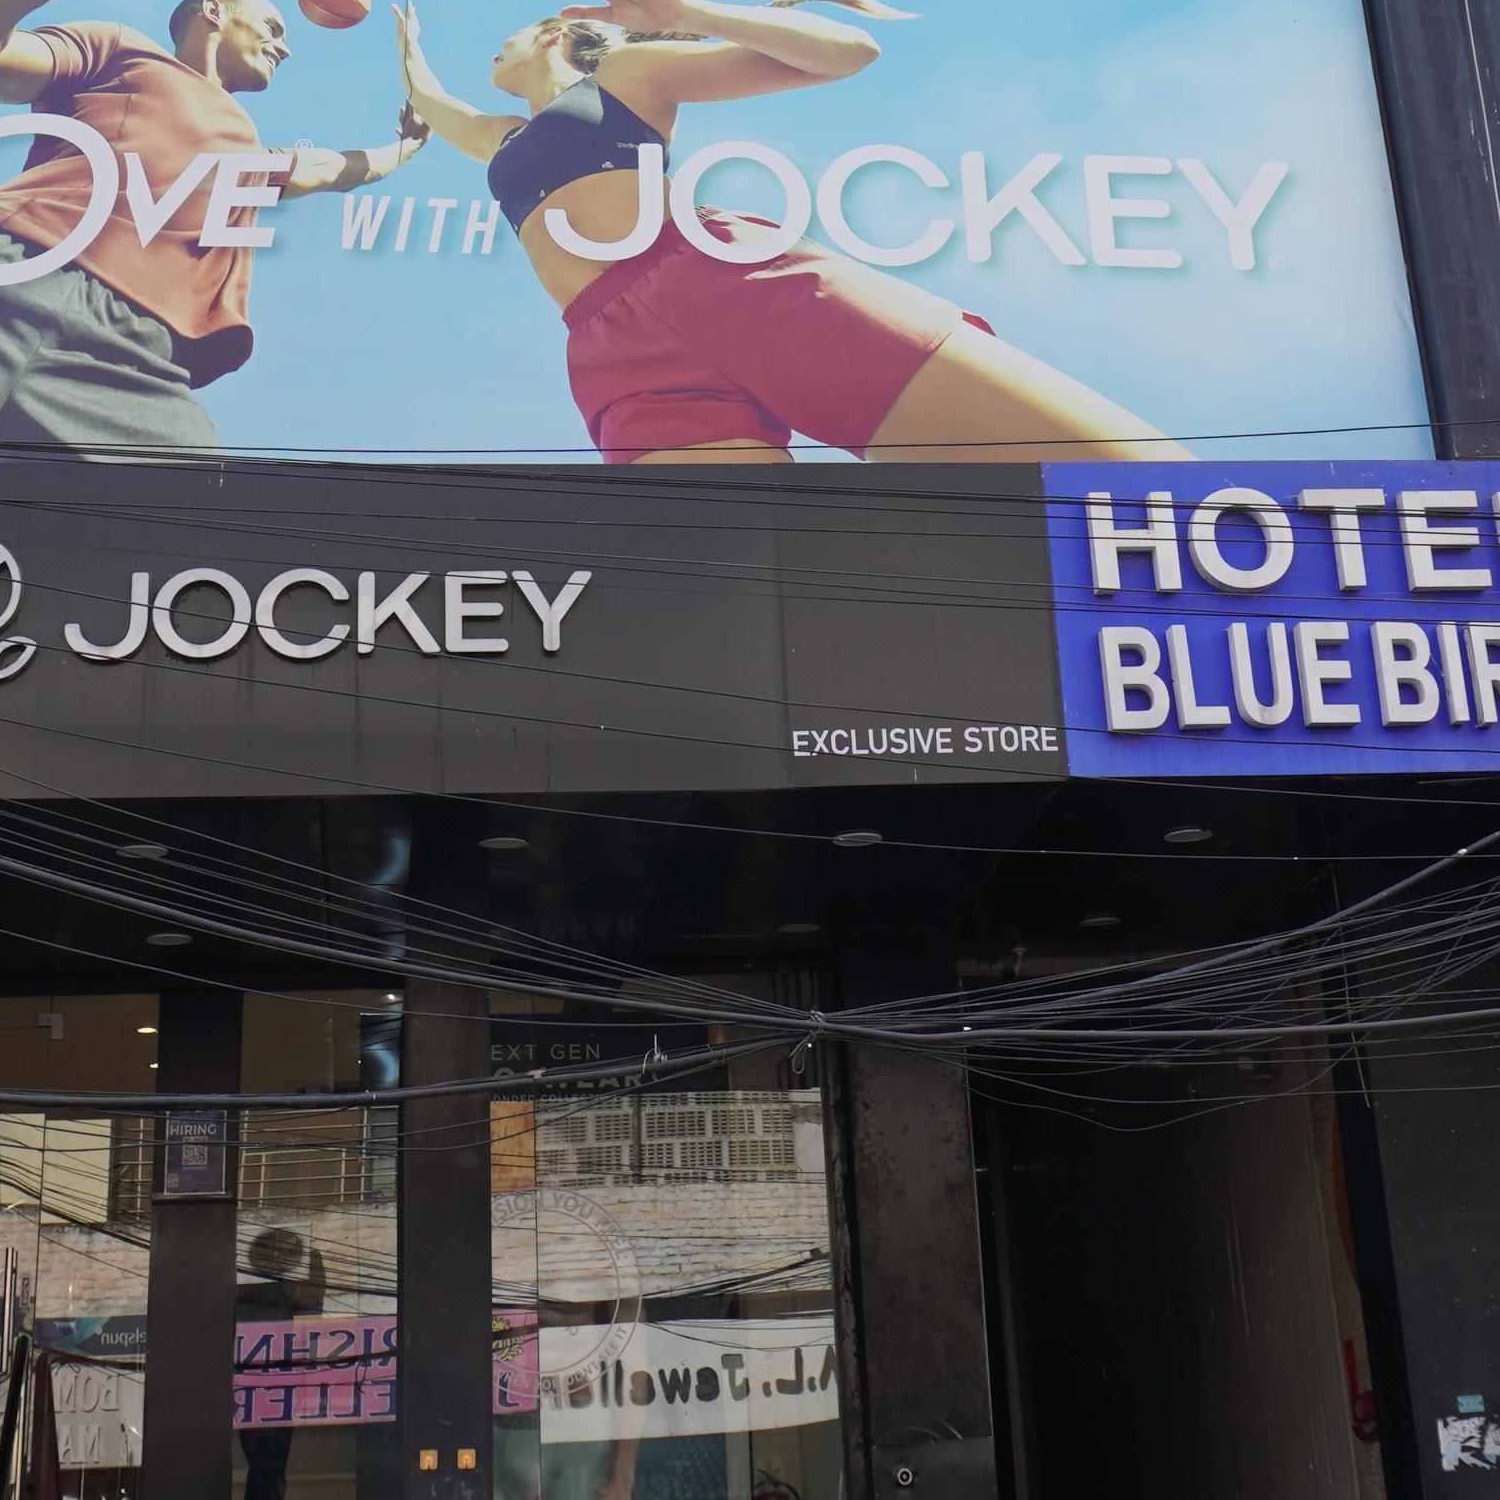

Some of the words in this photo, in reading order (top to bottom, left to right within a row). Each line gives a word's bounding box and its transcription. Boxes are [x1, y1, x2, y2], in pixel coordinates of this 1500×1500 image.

[341, 193, 500, 256] WITH
[543, 140, 1290, 272] JOCKEY
[63, 566, 593, 662] JOCKEY
[792, 728, 954, 757] EXCLUSIVE
[964, 725, 1059, 753] STORE
[490, 1043, 538, 1061] EXT
[549, 1043, 601, 1061] GEN
[169, 1124, 218, 1136] HIRING
